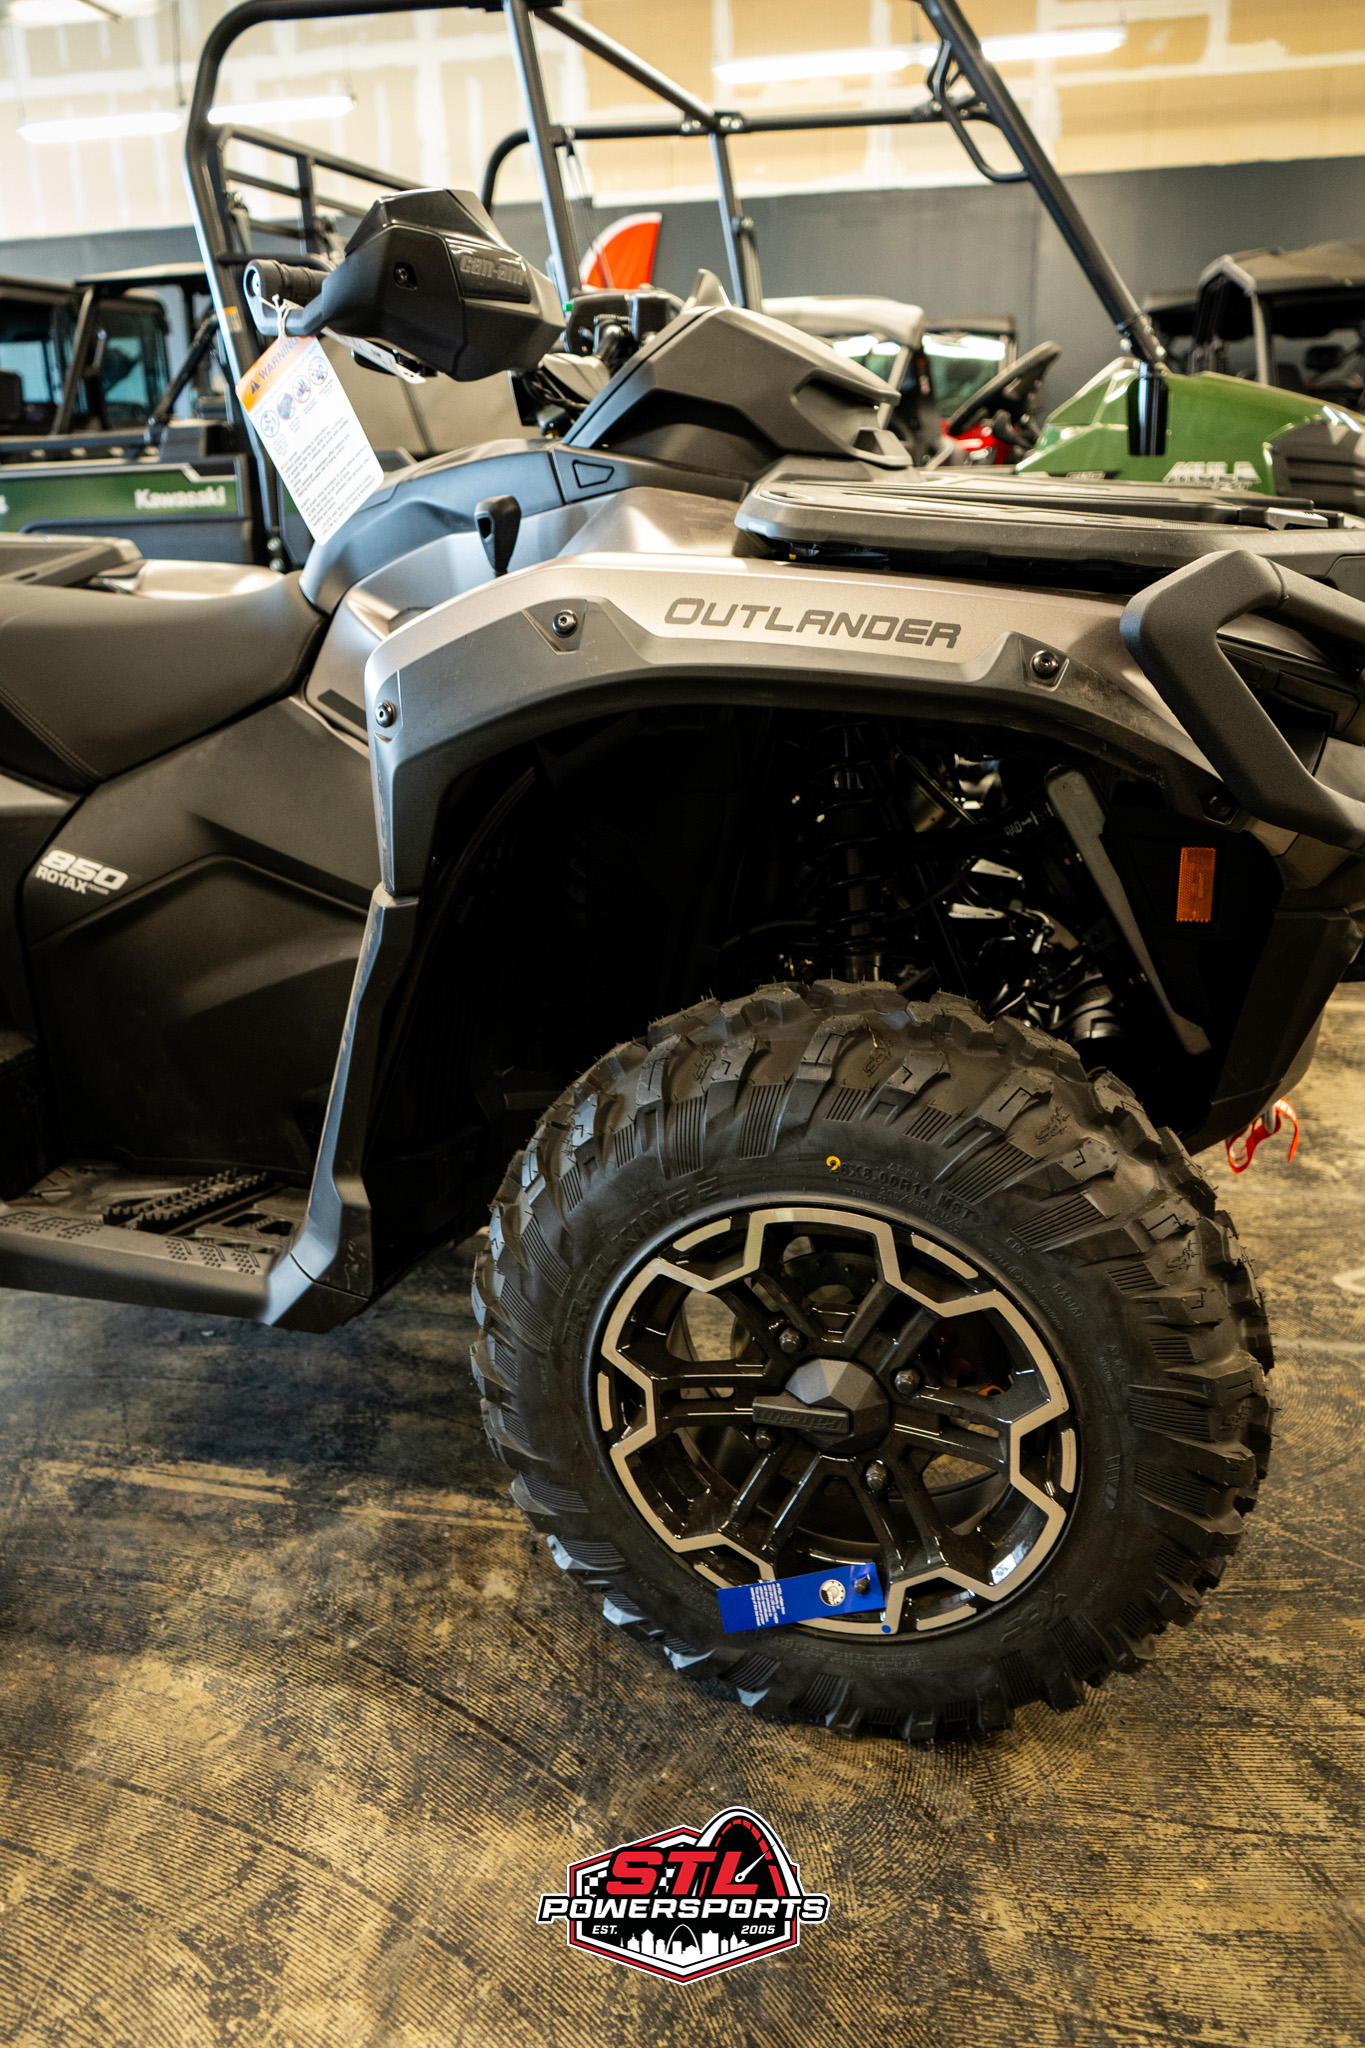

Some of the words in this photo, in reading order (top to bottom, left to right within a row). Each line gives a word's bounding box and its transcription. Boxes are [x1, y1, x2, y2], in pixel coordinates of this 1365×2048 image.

[258, 336, 299, 381] WARNING
[134, 486, 227, 509] Kawasaki
[664, 597, 962, 649] OUTLANDER
[35, 865, 87, 895] ROTAX
[41, 849, 129, 890] 850
